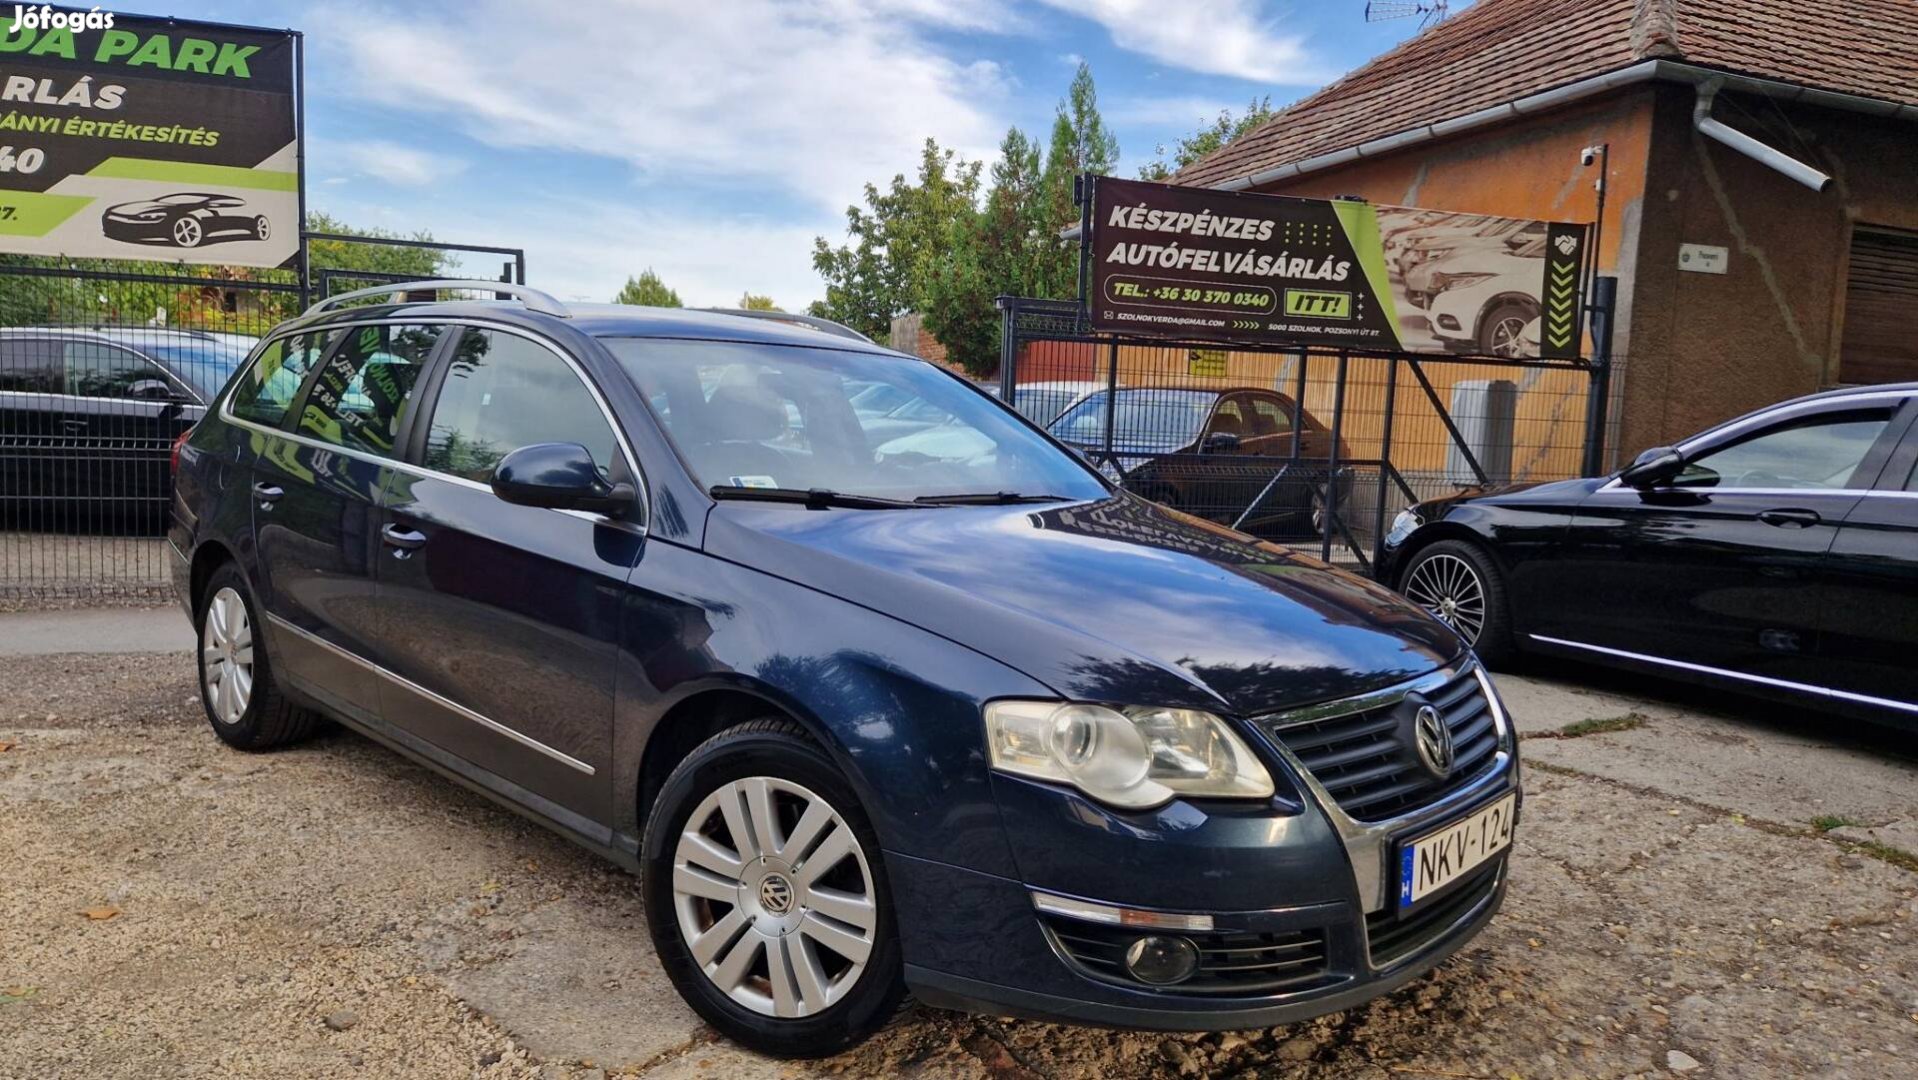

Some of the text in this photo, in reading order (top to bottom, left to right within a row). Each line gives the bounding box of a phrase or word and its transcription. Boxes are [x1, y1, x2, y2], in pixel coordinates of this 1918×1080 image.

[95, 30, 261, 78] PARK
[0, 110, 220, 147] ÁNYI ÉRTÉKESÍTÉS
[0, 206, 17, 220] 7.
[1108, 203, 1275, 241] KÉSZPÉNZES
[1106, 242, 1350, 281] AUTÓFELVÁSÁRLÁS
[1113, 282, 1269, 307] TEL.: +36 30 370 0340
[1294, 294, 1341, 313] ITT!
[1117, 312, 1225, 327] SZOLNOKVERDA@GMAIL.COM
[1419, 802, 1509, 891] NKV-124
[1401, 880, 1410, 898] H
